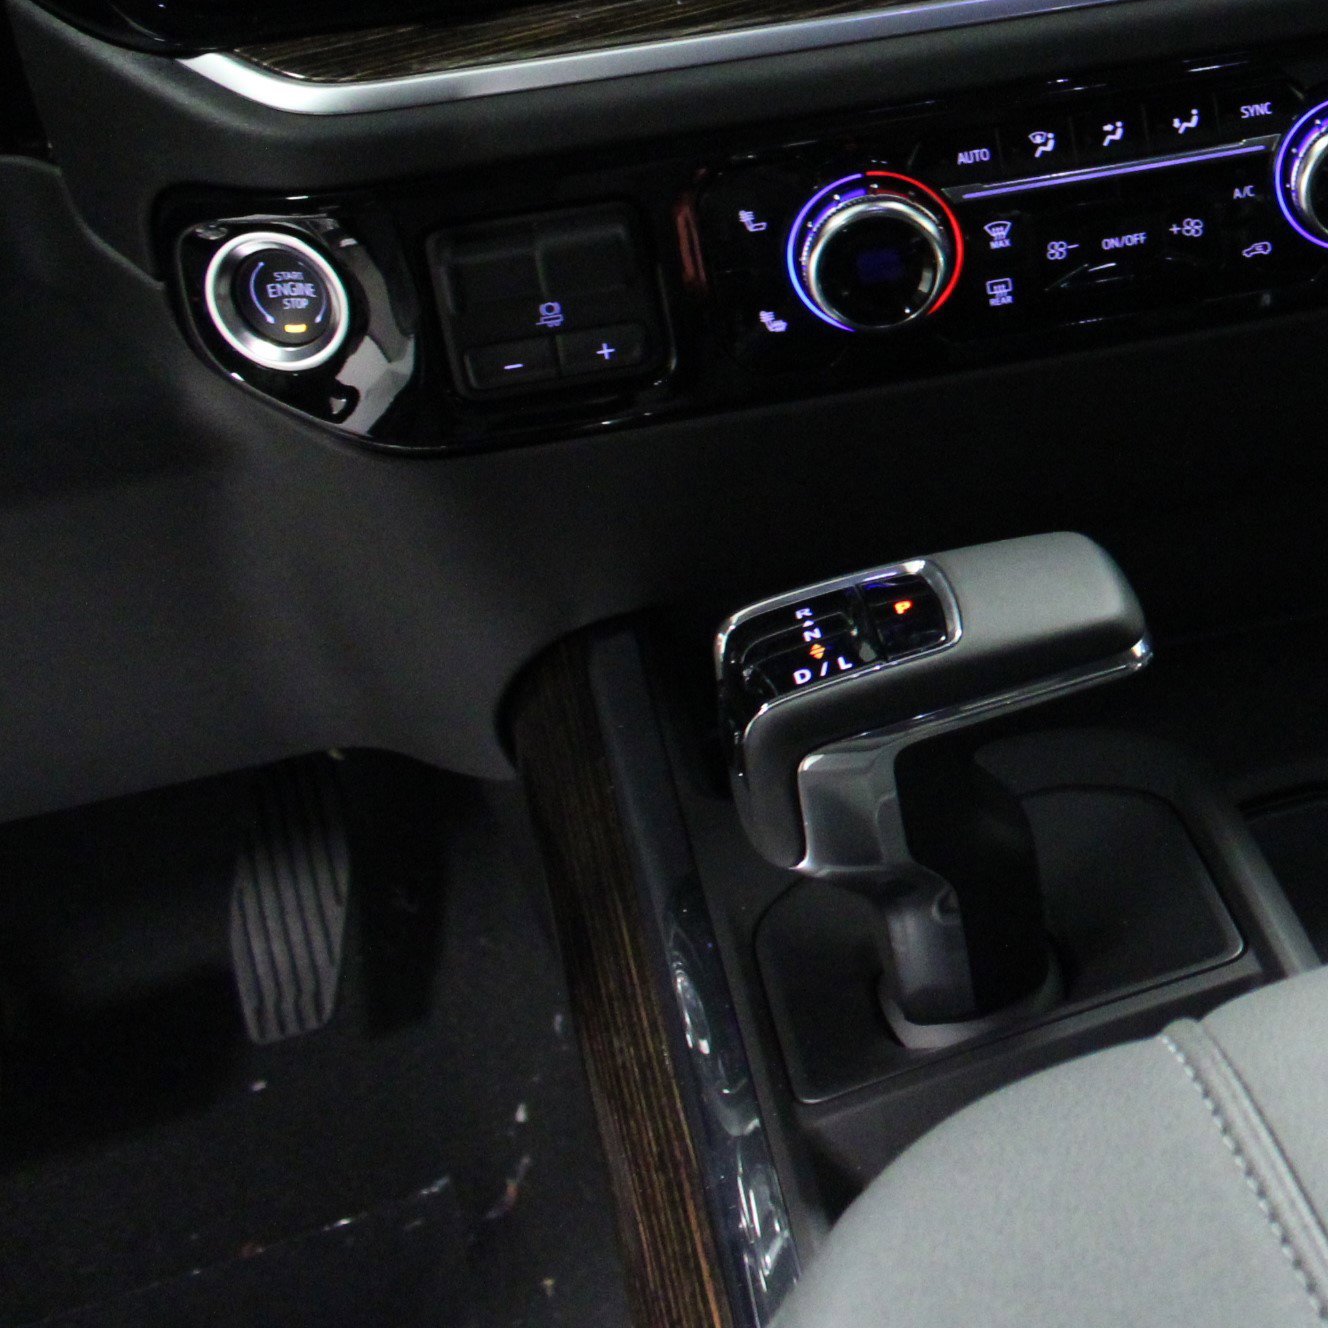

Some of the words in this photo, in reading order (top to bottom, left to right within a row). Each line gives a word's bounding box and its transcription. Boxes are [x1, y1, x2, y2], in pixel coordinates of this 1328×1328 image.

[1240, 101, 1272, 118] SYNC
[957, 147, 991, 166] AUTO
[1233, 184, 1255, 201] A/C
[1101, 231, 1147, 251] ON/OFF
[266, 281, 318, 298] ENGINE
[282, 297, 309, 310] STOP
[795, 608, 812, 619] R
[894, 601, 912, 614] P
[803, 628, 822, 642] N
